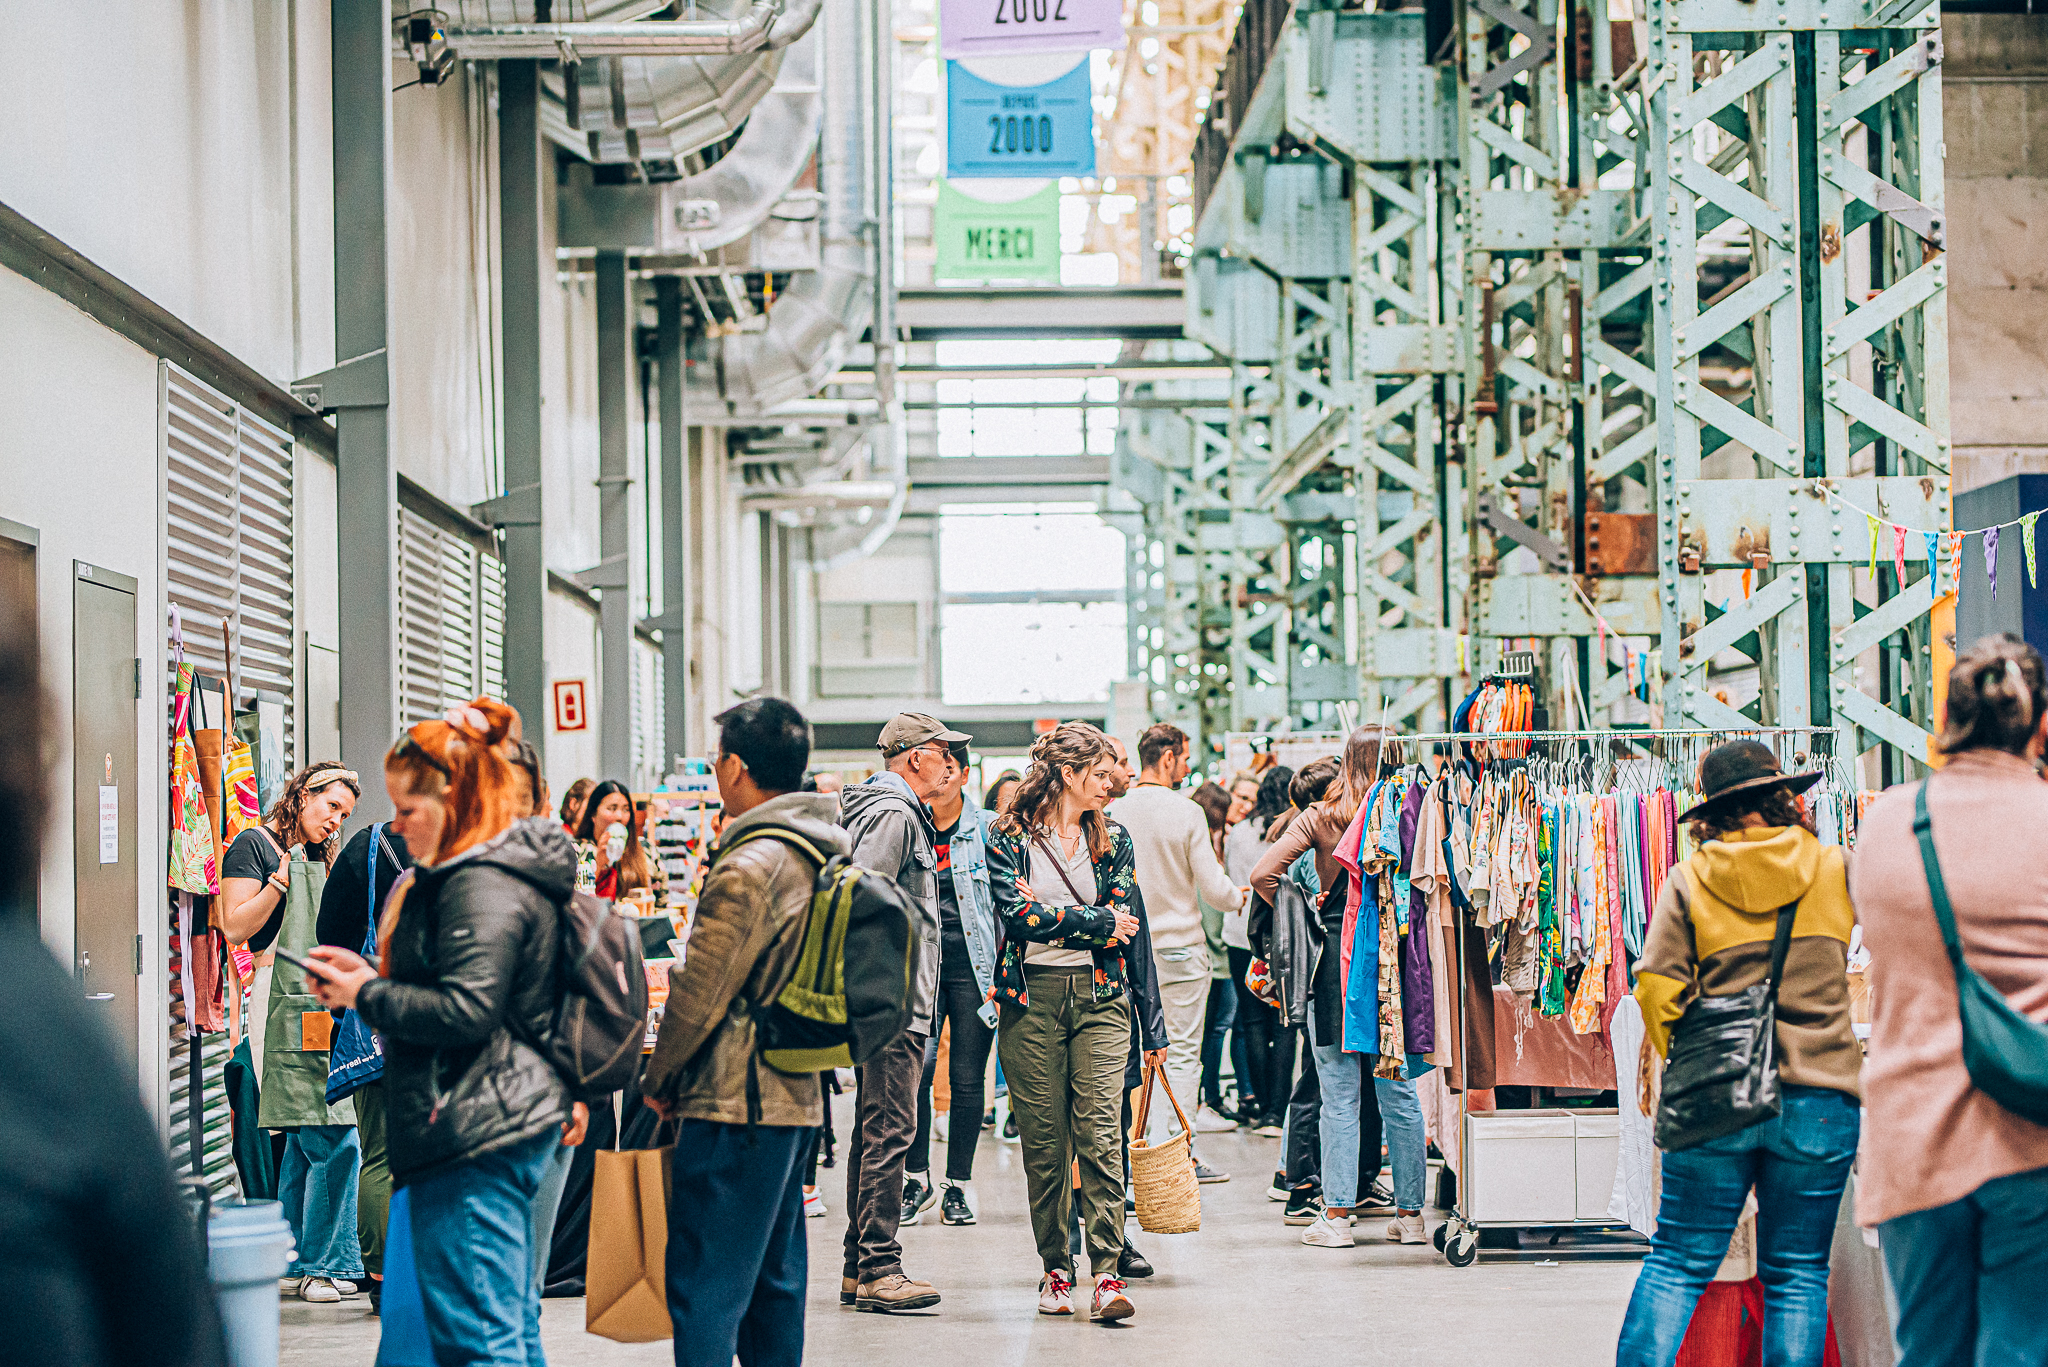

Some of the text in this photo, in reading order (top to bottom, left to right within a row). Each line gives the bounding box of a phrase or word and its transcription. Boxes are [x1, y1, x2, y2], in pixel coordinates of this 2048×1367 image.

[990, 116, 1052, 154] 2000
[967, 228, 1035, 260] MERCI
[347, 1056, 361, 1069] real
